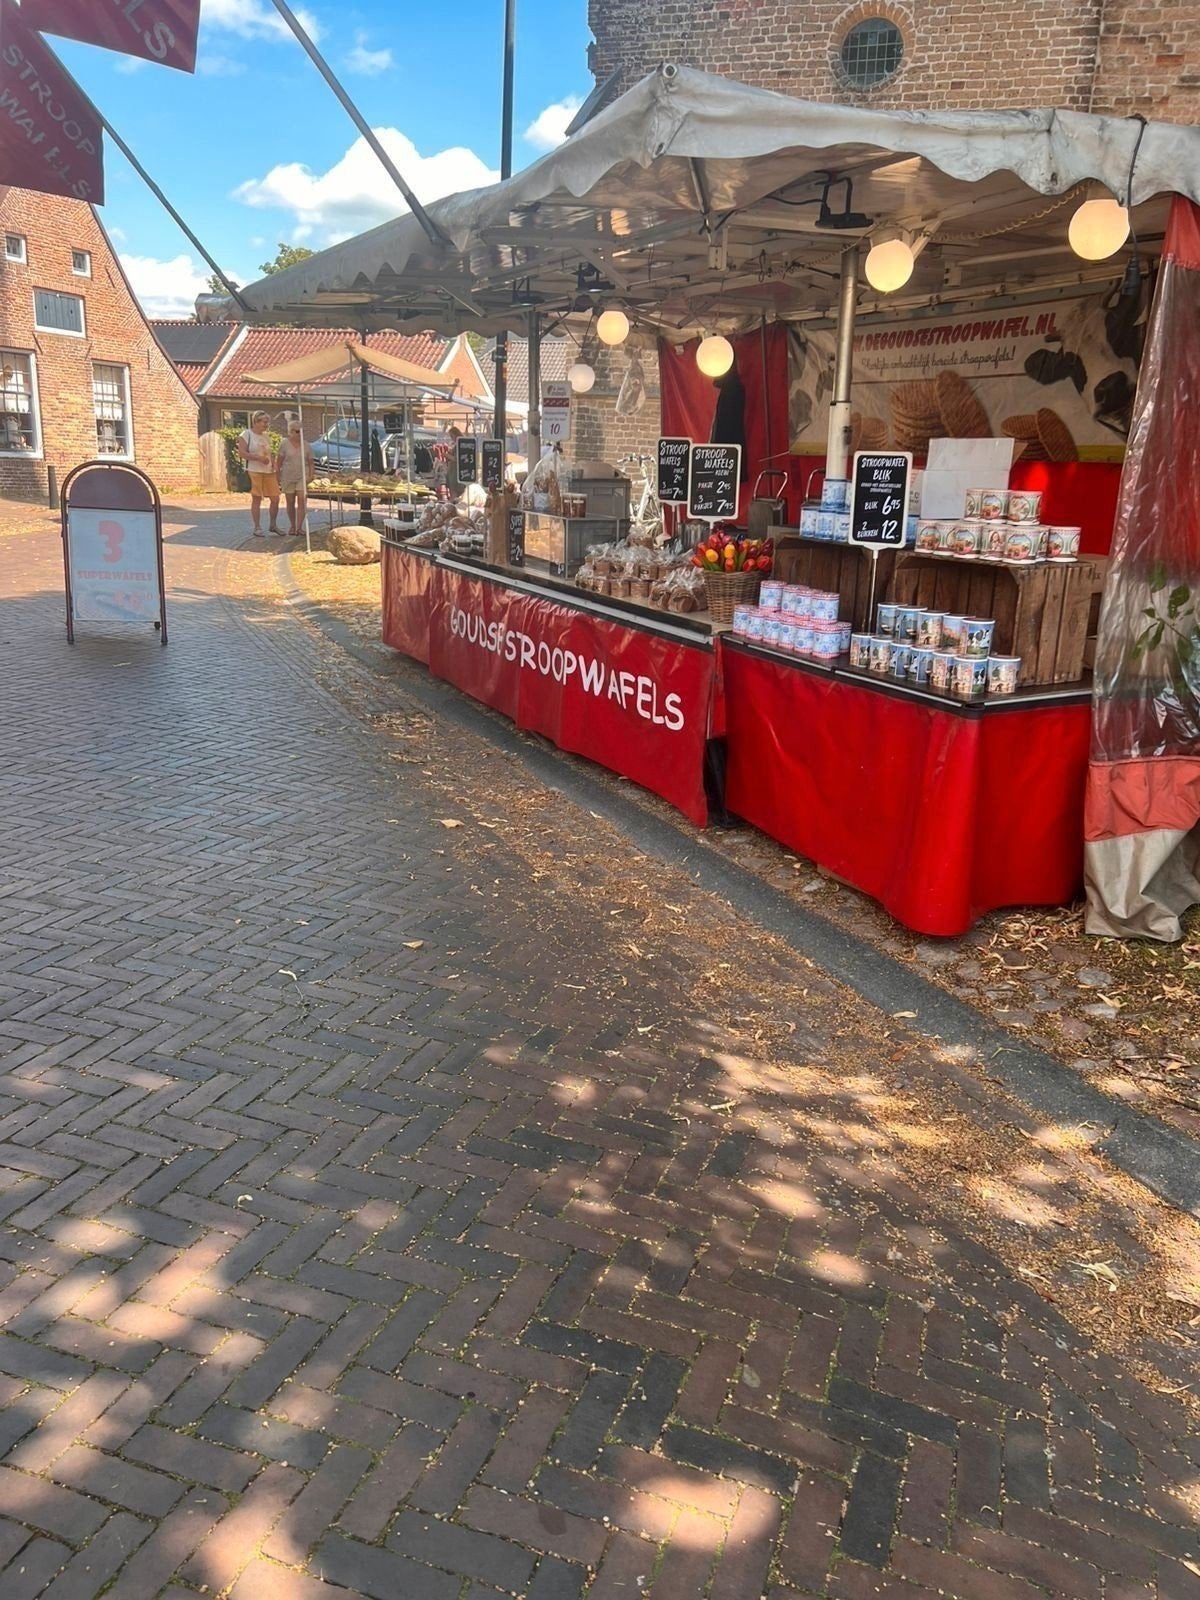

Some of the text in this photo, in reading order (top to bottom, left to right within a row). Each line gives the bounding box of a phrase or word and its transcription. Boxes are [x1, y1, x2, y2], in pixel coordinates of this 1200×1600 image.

[113, 0, 176, 59] LS
[2, 43, 95, 156] STROOP
[550, 423, 561, 435] 10
[660, 441, 688, 456] STROOP
[695, 448, 727, 460] STROOP
[660, 456, 681, 467] WAFELS
[704, 458, 735, 470] WAFELS
[861, 457, 906, 468] STROOPWAFEL
[872, 469, 892, 481] BLIK
[698, 494, 704, 503] 3
[864, 501, 879, 511] BLIK
[862, 521, 868, 531] 2
[857, 528, 879, 538] BLIKKEN
[98, 519, 126, 564] 3
[450, 604, 685, 731] GOUDSE STROOPWAFELS
